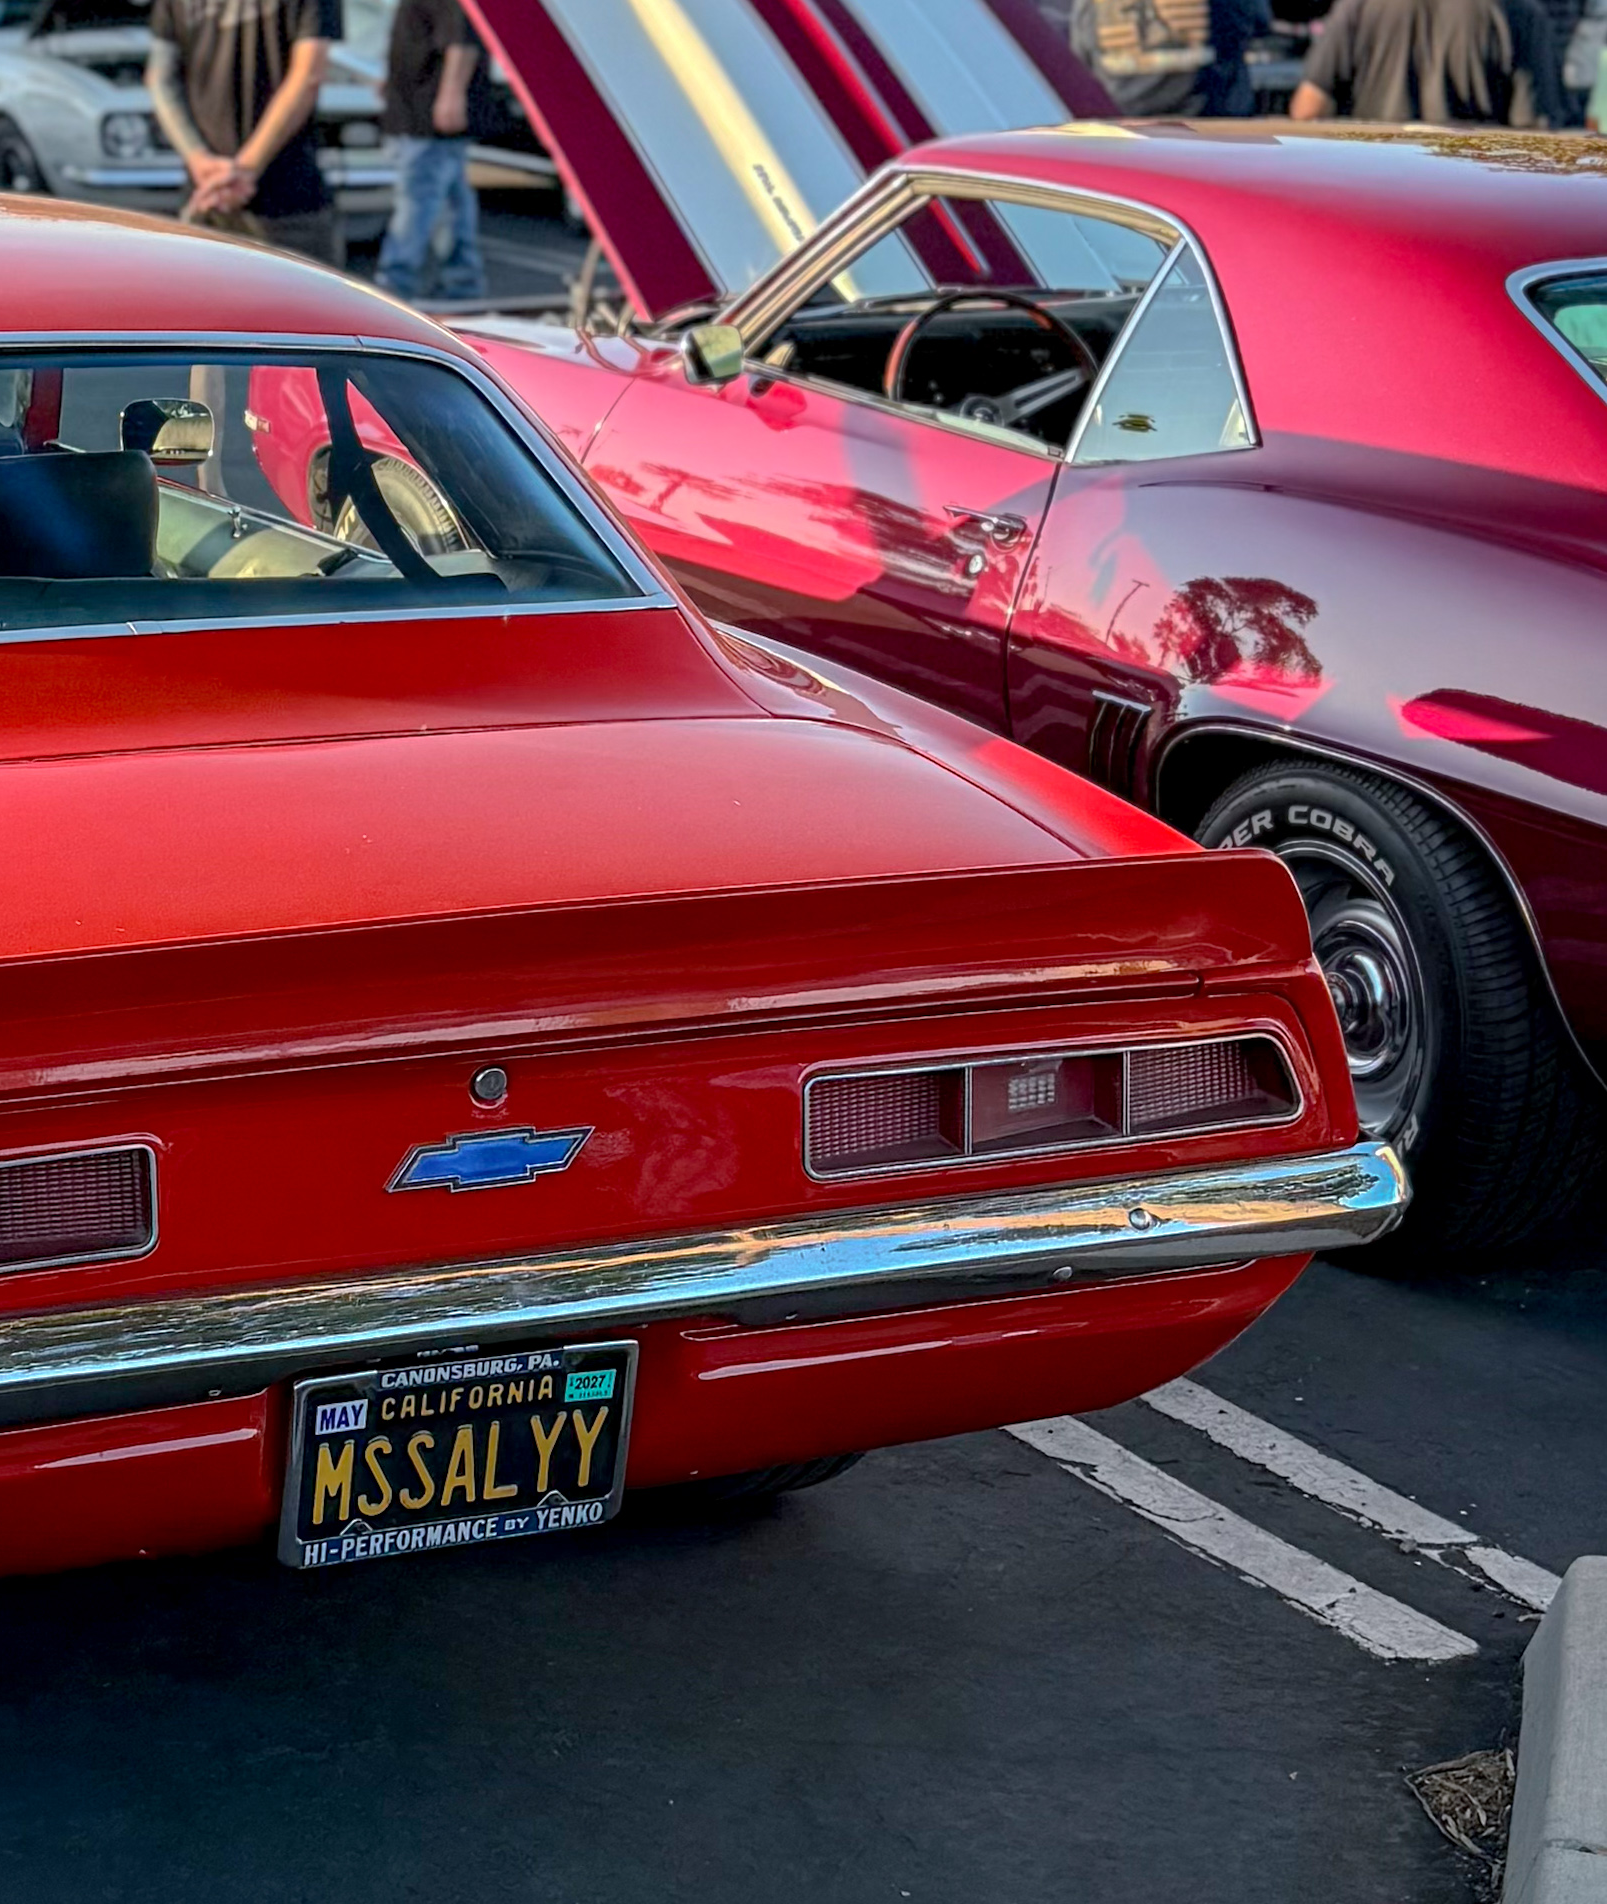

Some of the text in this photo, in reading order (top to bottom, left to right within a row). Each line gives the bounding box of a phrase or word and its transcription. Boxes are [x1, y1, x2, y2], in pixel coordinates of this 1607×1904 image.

[1288, 805, 1395, 886] COBRA
[381, 1354, 560, 1388] CANONSBURG, PA.
[575, 1374, 607, 1390] 2027
[320, 1403, 364, 1432] MAY
[381, 1375, 553, 1421] CALIFORNIA
[312, 1406, 609, 1524] MSSALYY
[304, 1502, 603, 1566] HI-PERFORMANCE BY YENKO
